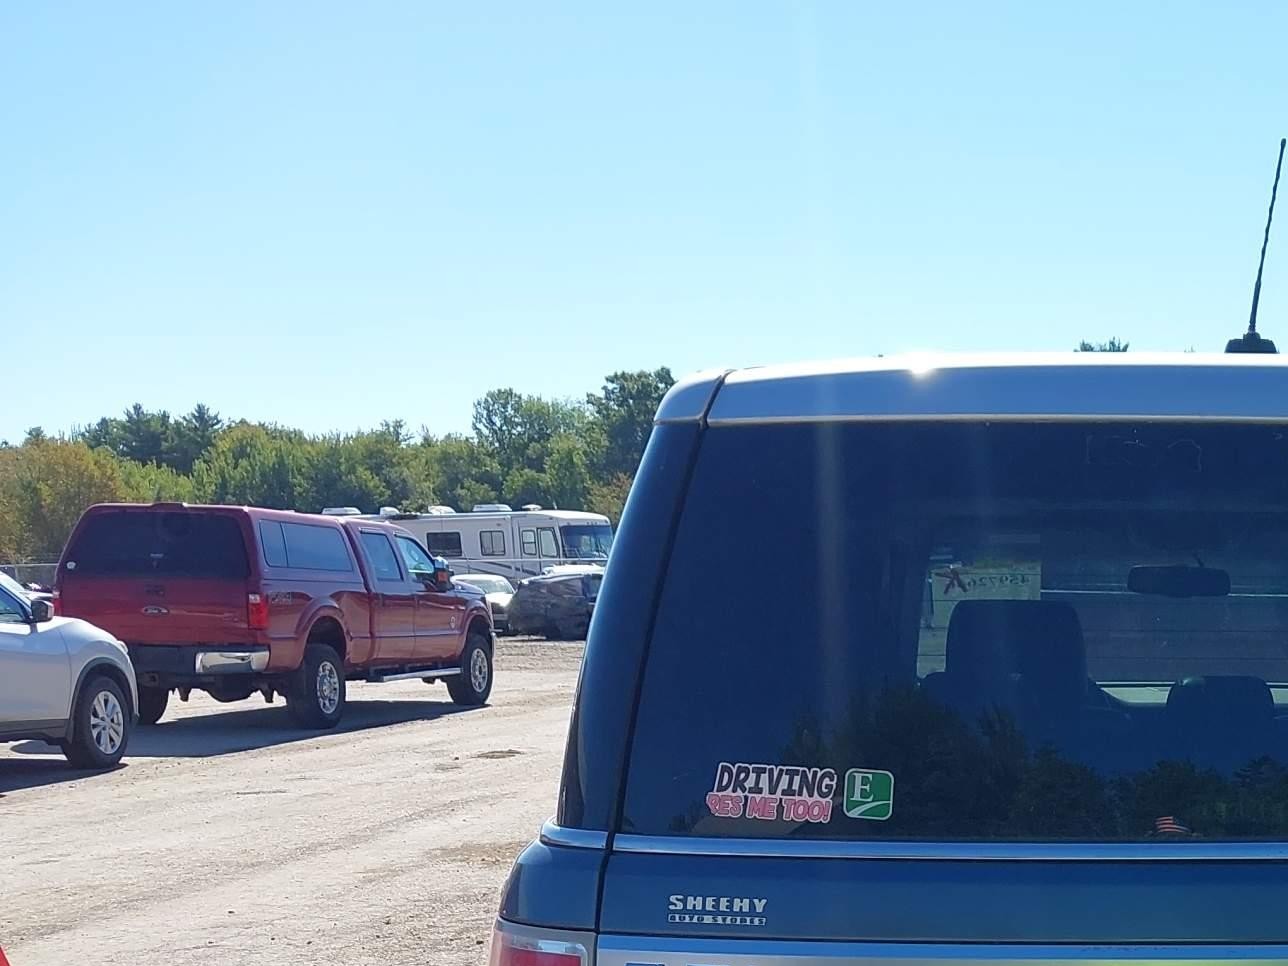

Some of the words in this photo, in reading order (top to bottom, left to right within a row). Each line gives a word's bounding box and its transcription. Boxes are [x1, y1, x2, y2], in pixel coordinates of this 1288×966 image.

[716, 763, 836, 798] DRIVING
[850, 772, 874, 802] E
[748, 796, 777, 818] ME
[784, 799, 832, 822] TOO!
[668, 894, 768, 913] SHEEHY
[669, 914, 705, 923] AUTO
[711, 915, 765, 925] STORES
